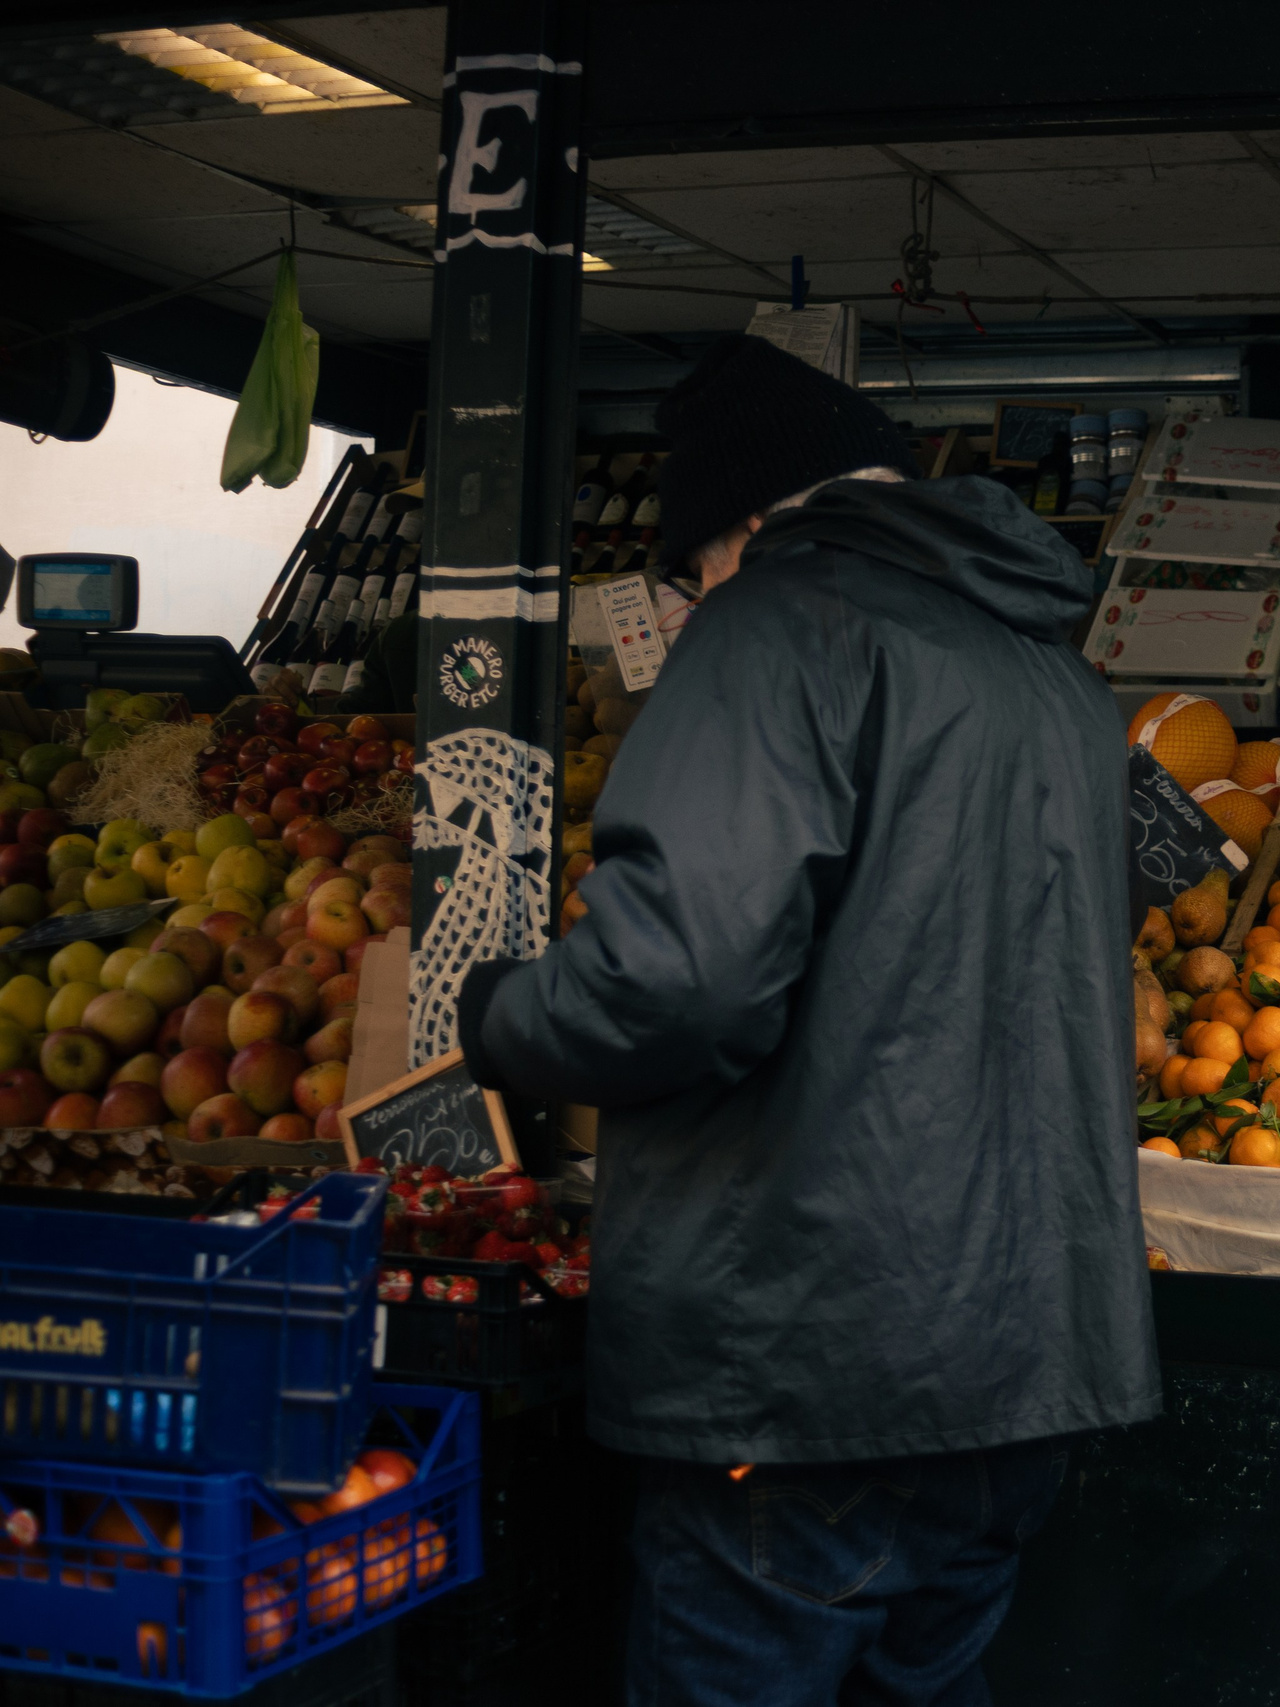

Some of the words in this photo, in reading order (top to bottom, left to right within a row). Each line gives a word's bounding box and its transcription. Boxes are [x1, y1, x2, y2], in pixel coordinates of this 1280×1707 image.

[449, 89, 538, 214] E
[612, 581, 640, 594] axerve
[612, 597, 622, 606] Qui
[624, 595, 637, 604] puoi
[611, 604, 632, 614] pagare
[452, 637, 503, 679] MANERO
[440, 653, 470, 708] BURGER
